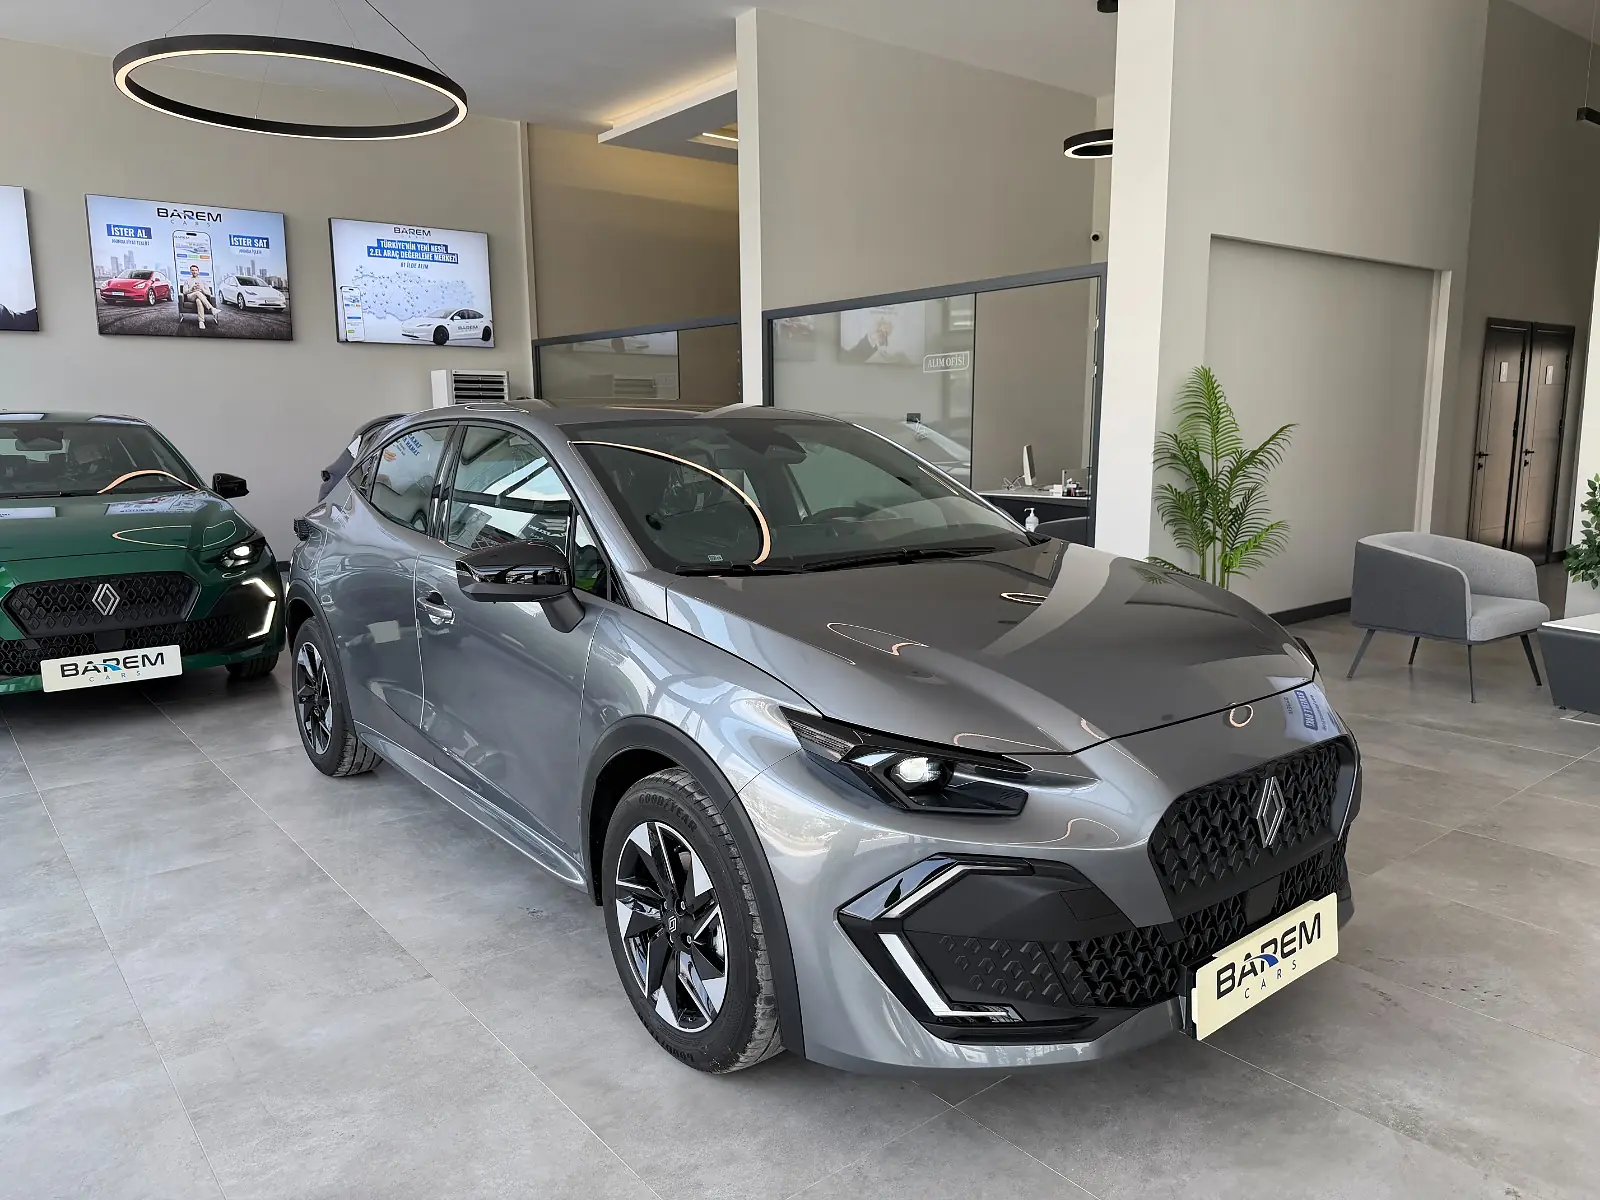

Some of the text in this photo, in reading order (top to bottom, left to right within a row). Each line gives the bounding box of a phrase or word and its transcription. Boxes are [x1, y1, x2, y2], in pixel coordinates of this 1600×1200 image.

[157, 208, 222, 222] BAREM
[170, 219, 211, 227] CARS
[111, 224, 147, 238] İSTER AL
[394, 227, 432, 236] BAREM
[231, 235, 267, 248] İSTER SAT
[380, 240, 447, 253] TÜRKİYE'NİN YENİ NESİL
[369, 248, 457, 263] 2.EL ARAÇ DEĞERLEME MERKEZİ
[927, 353, 965, 368] ALIM OFİSİ
[60, 652, 165, 678] BAREM
[88, 671, 141, 682] CARS
[1217, 912, 1321, 1000] BAREM
[1244, 959, 1297, 999] CARS
